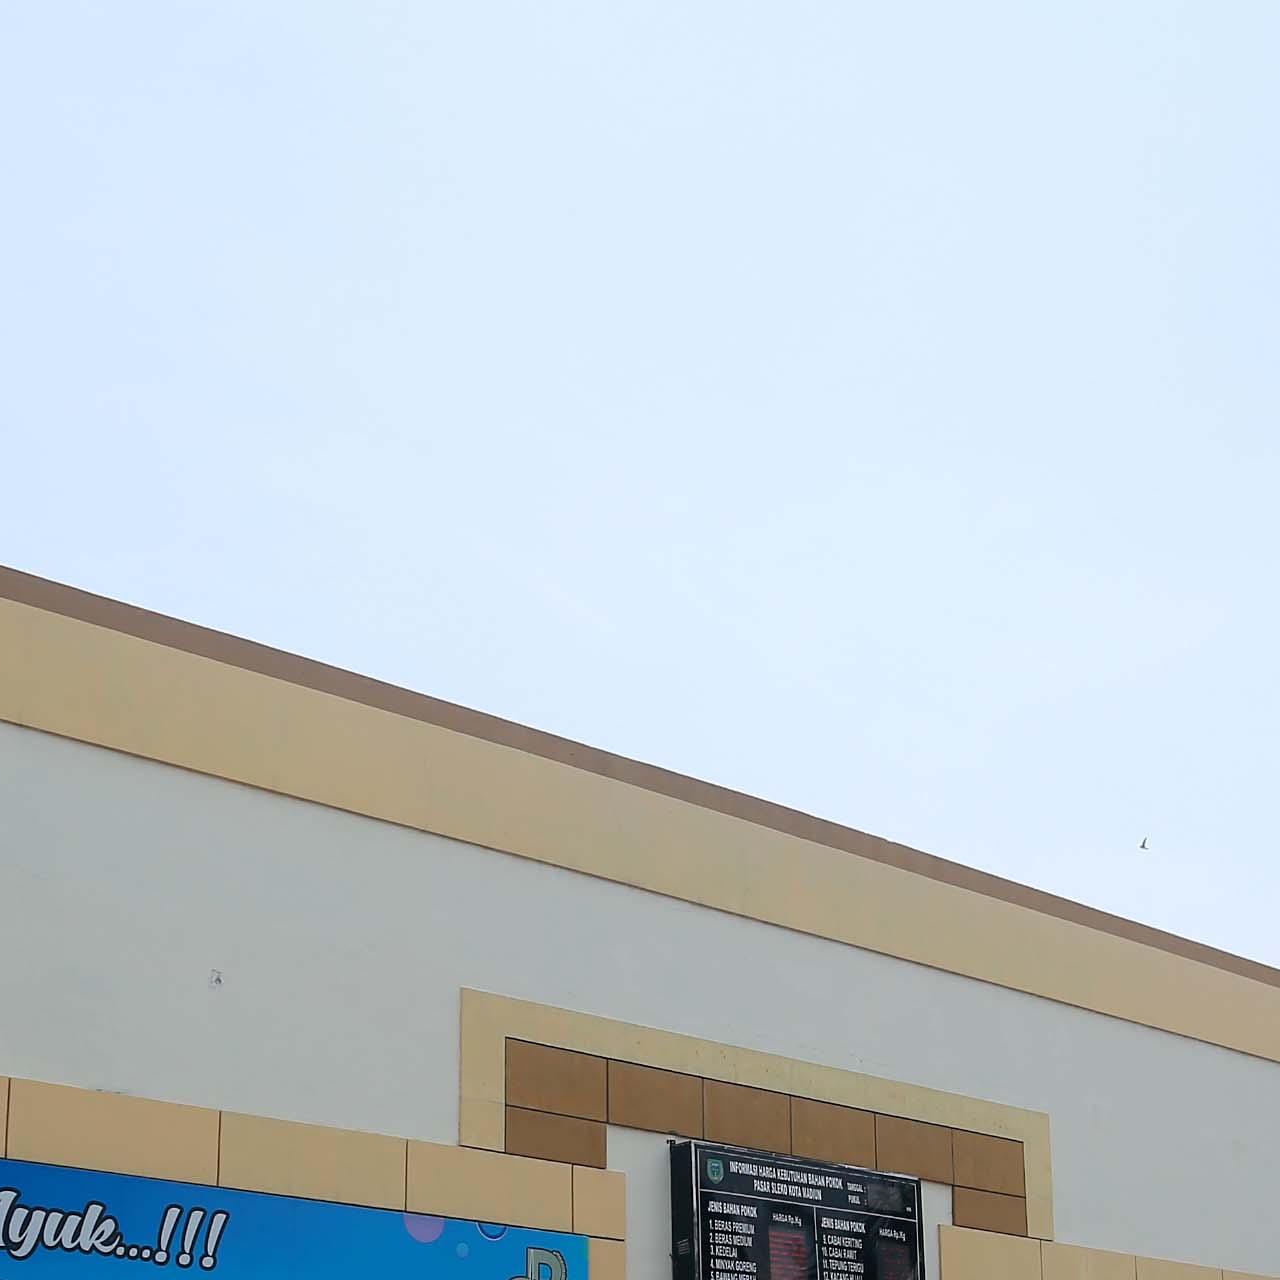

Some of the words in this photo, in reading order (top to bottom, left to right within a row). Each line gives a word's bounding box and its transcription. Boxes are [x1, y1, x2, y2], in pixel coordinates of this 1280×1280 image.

[729, 1161, 759, 1176] INFORMASI
[759, 1165, 777, 1179] HARGA
[777, 1167, 808, 1185] KEBUTUHAN
[808, 1171, 825, 1187] BAHAN
[825, 1174, 843, 1190] POKOK
[754, 1180, 770, 1193] PASAR
[771, 1182, 788, 1195] SLEKO
[788, 1184, 803, 1198] KOTA
[802, 1186, 822, 1201] MADIUN
[708, 1201, 722, 1213] JENIS
[723, 1202, 740, 1215] BAHAN
[740, 1205, 758, 1218] POKOK
[714, 1219, 732, 1232] BERAS
[732, 1222, 755, 1235] PREMIUM
[715, 1233, 732, 1245] BERAS
[715, 1245, 738, 1258] KEDELAI
[735, 1261, 757, 1273] GORENG
